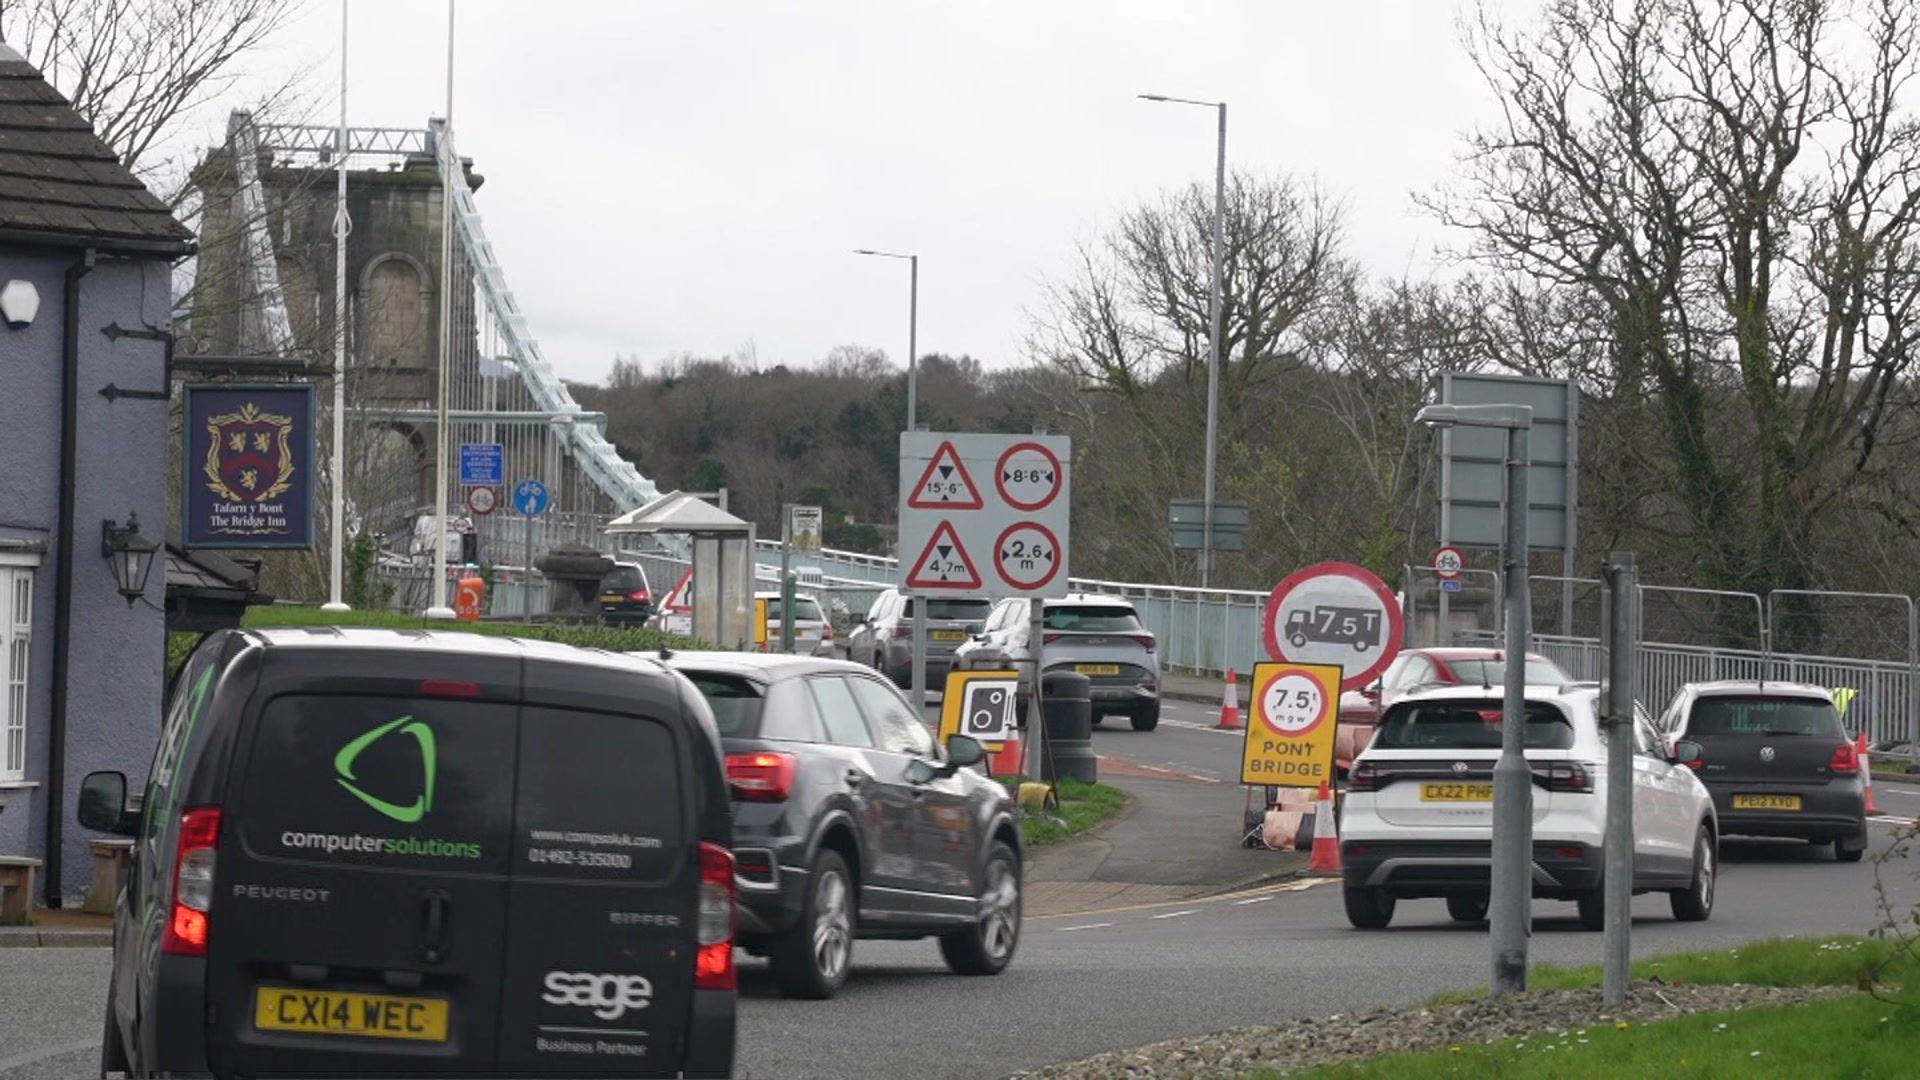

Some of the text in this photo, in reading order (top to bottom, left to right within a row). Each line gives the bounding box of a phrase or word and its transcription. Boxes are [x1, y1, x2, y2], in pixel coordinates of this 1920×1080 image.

[213, 502, 284, 516] Tafarn y Bont
[210, 515, 286, 528] The Bridge Inn
[1020, 559, 1034, 570] m
[1262, 741, 1316, 756] PONT
[1250, 759, 1323, 777] BRIDGE
[1425, 784, 1465, 799] CX22
[281, 831, 481, 858] computersolutions
[528, 848, 633, 869] 01492-535000
[232, 884, 331, 902] PEUGEOT
[541, 970, 653, 1020] sage
[278, 994, 426, 1032] CX14 WEC
[536, 1036, 648, 1056] Business Partner
